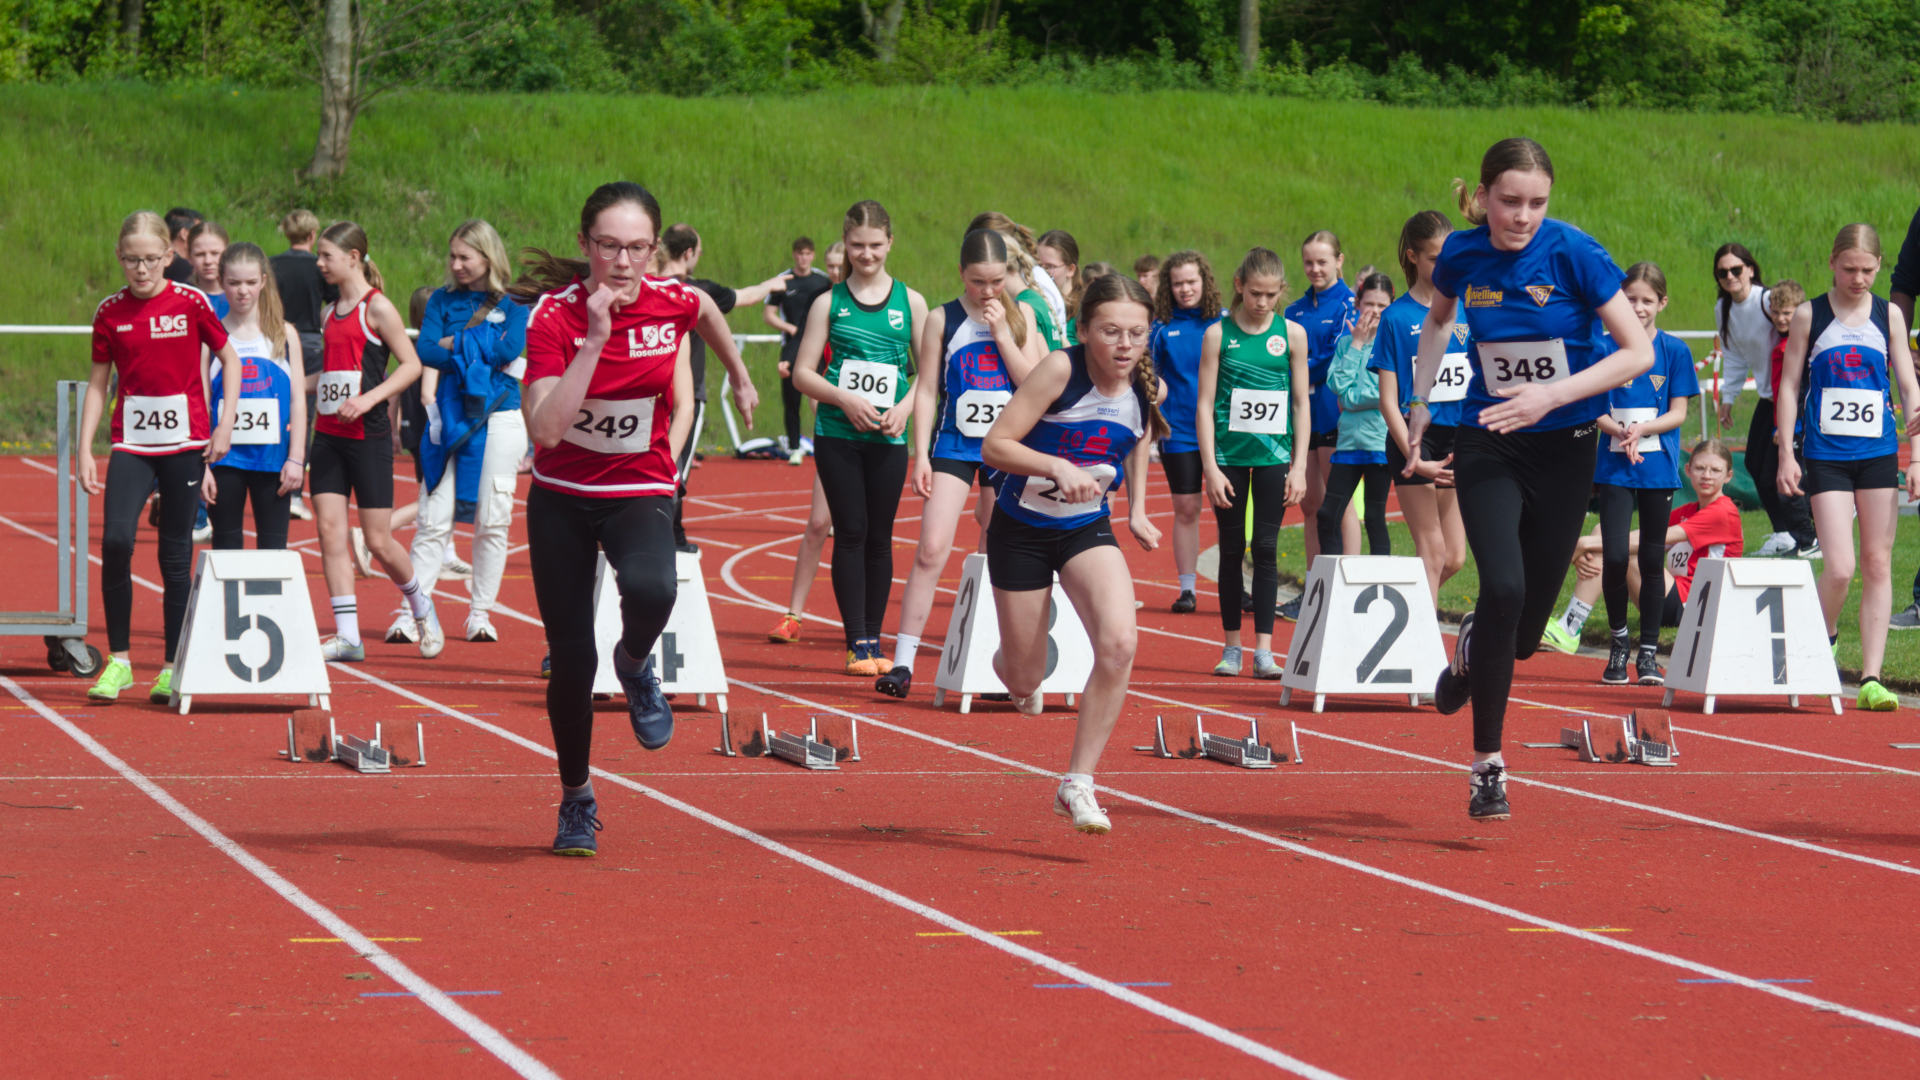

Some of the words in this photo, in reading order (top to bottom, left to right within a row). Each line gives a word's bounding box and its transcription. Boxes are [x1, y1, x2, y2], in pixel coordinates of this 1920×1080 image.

[629, 343, 677, 358] Rosendahl
[960, 352, 975, 370] LG
[1431, 366, 1465, 388] 45
[1493, 357, 1556, 383] 348
[321, 383, 351, 402] 384
[847, 372, 888, 394] 306
[132, 409, 179, 430] 248
[1239, 401, 1279, 421] 397
[1830, 401, 1875, 423] 236
[573, 408, 639, 439] 249
[1671, 551, 1689, 569] 192
[223, 580, 285, 684] 5
[947, 576, 974, 677] 3
[1293, 577, 1325, 677] 2
[1353, 583, 1413, 684] 2
[1686, 580, 1712, 678] 1
[1755, 587, 1788, 685] 1
